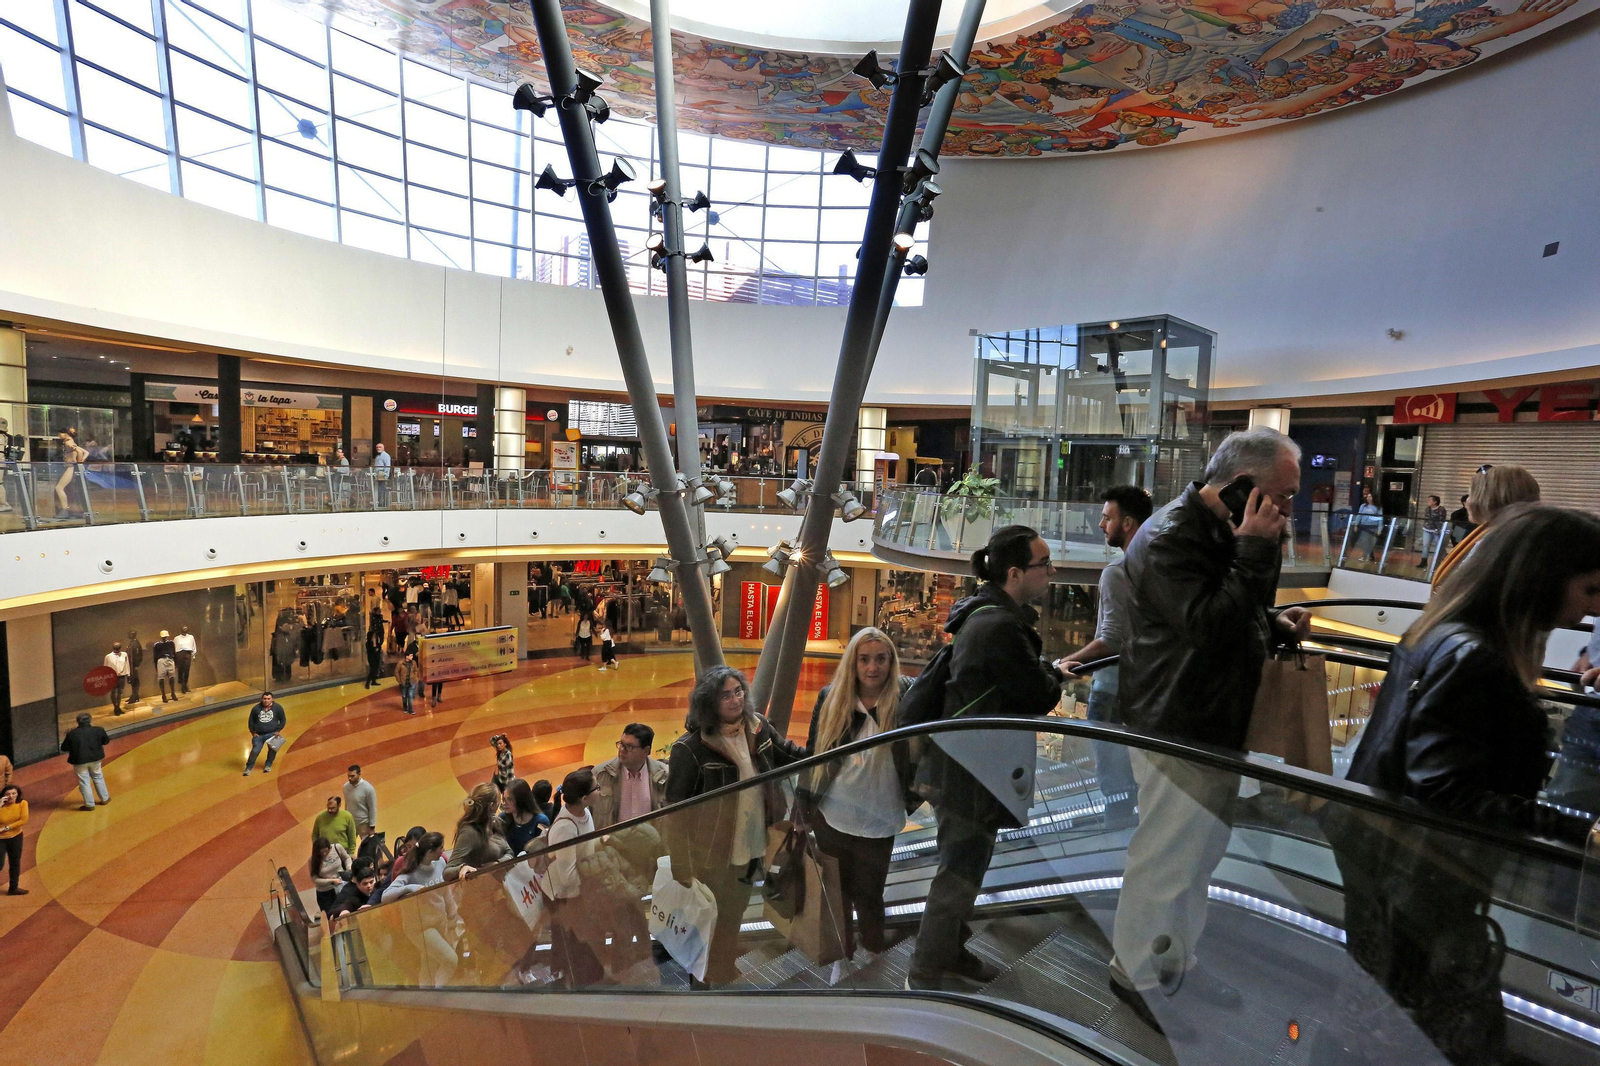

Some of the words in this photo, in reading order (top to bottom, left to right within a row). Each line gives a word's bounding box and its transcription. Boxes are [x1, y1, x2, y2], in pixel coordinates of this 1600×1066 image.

[199, 390, 219, 400] Cas
[270, 395, 292, 405] tapa
[1482, 383, 1600, 423] YE
[775, 411, 788, 419] DE
[791, 412, 823, 421] INDIAS
[747, 583, 755, 609] HASTA
[815, 585, 823, 610] HASTA
[747, 610, 754, 619] EL
[815, 611, 822, 620] EL
[520, 874, 541, 908] H&M
